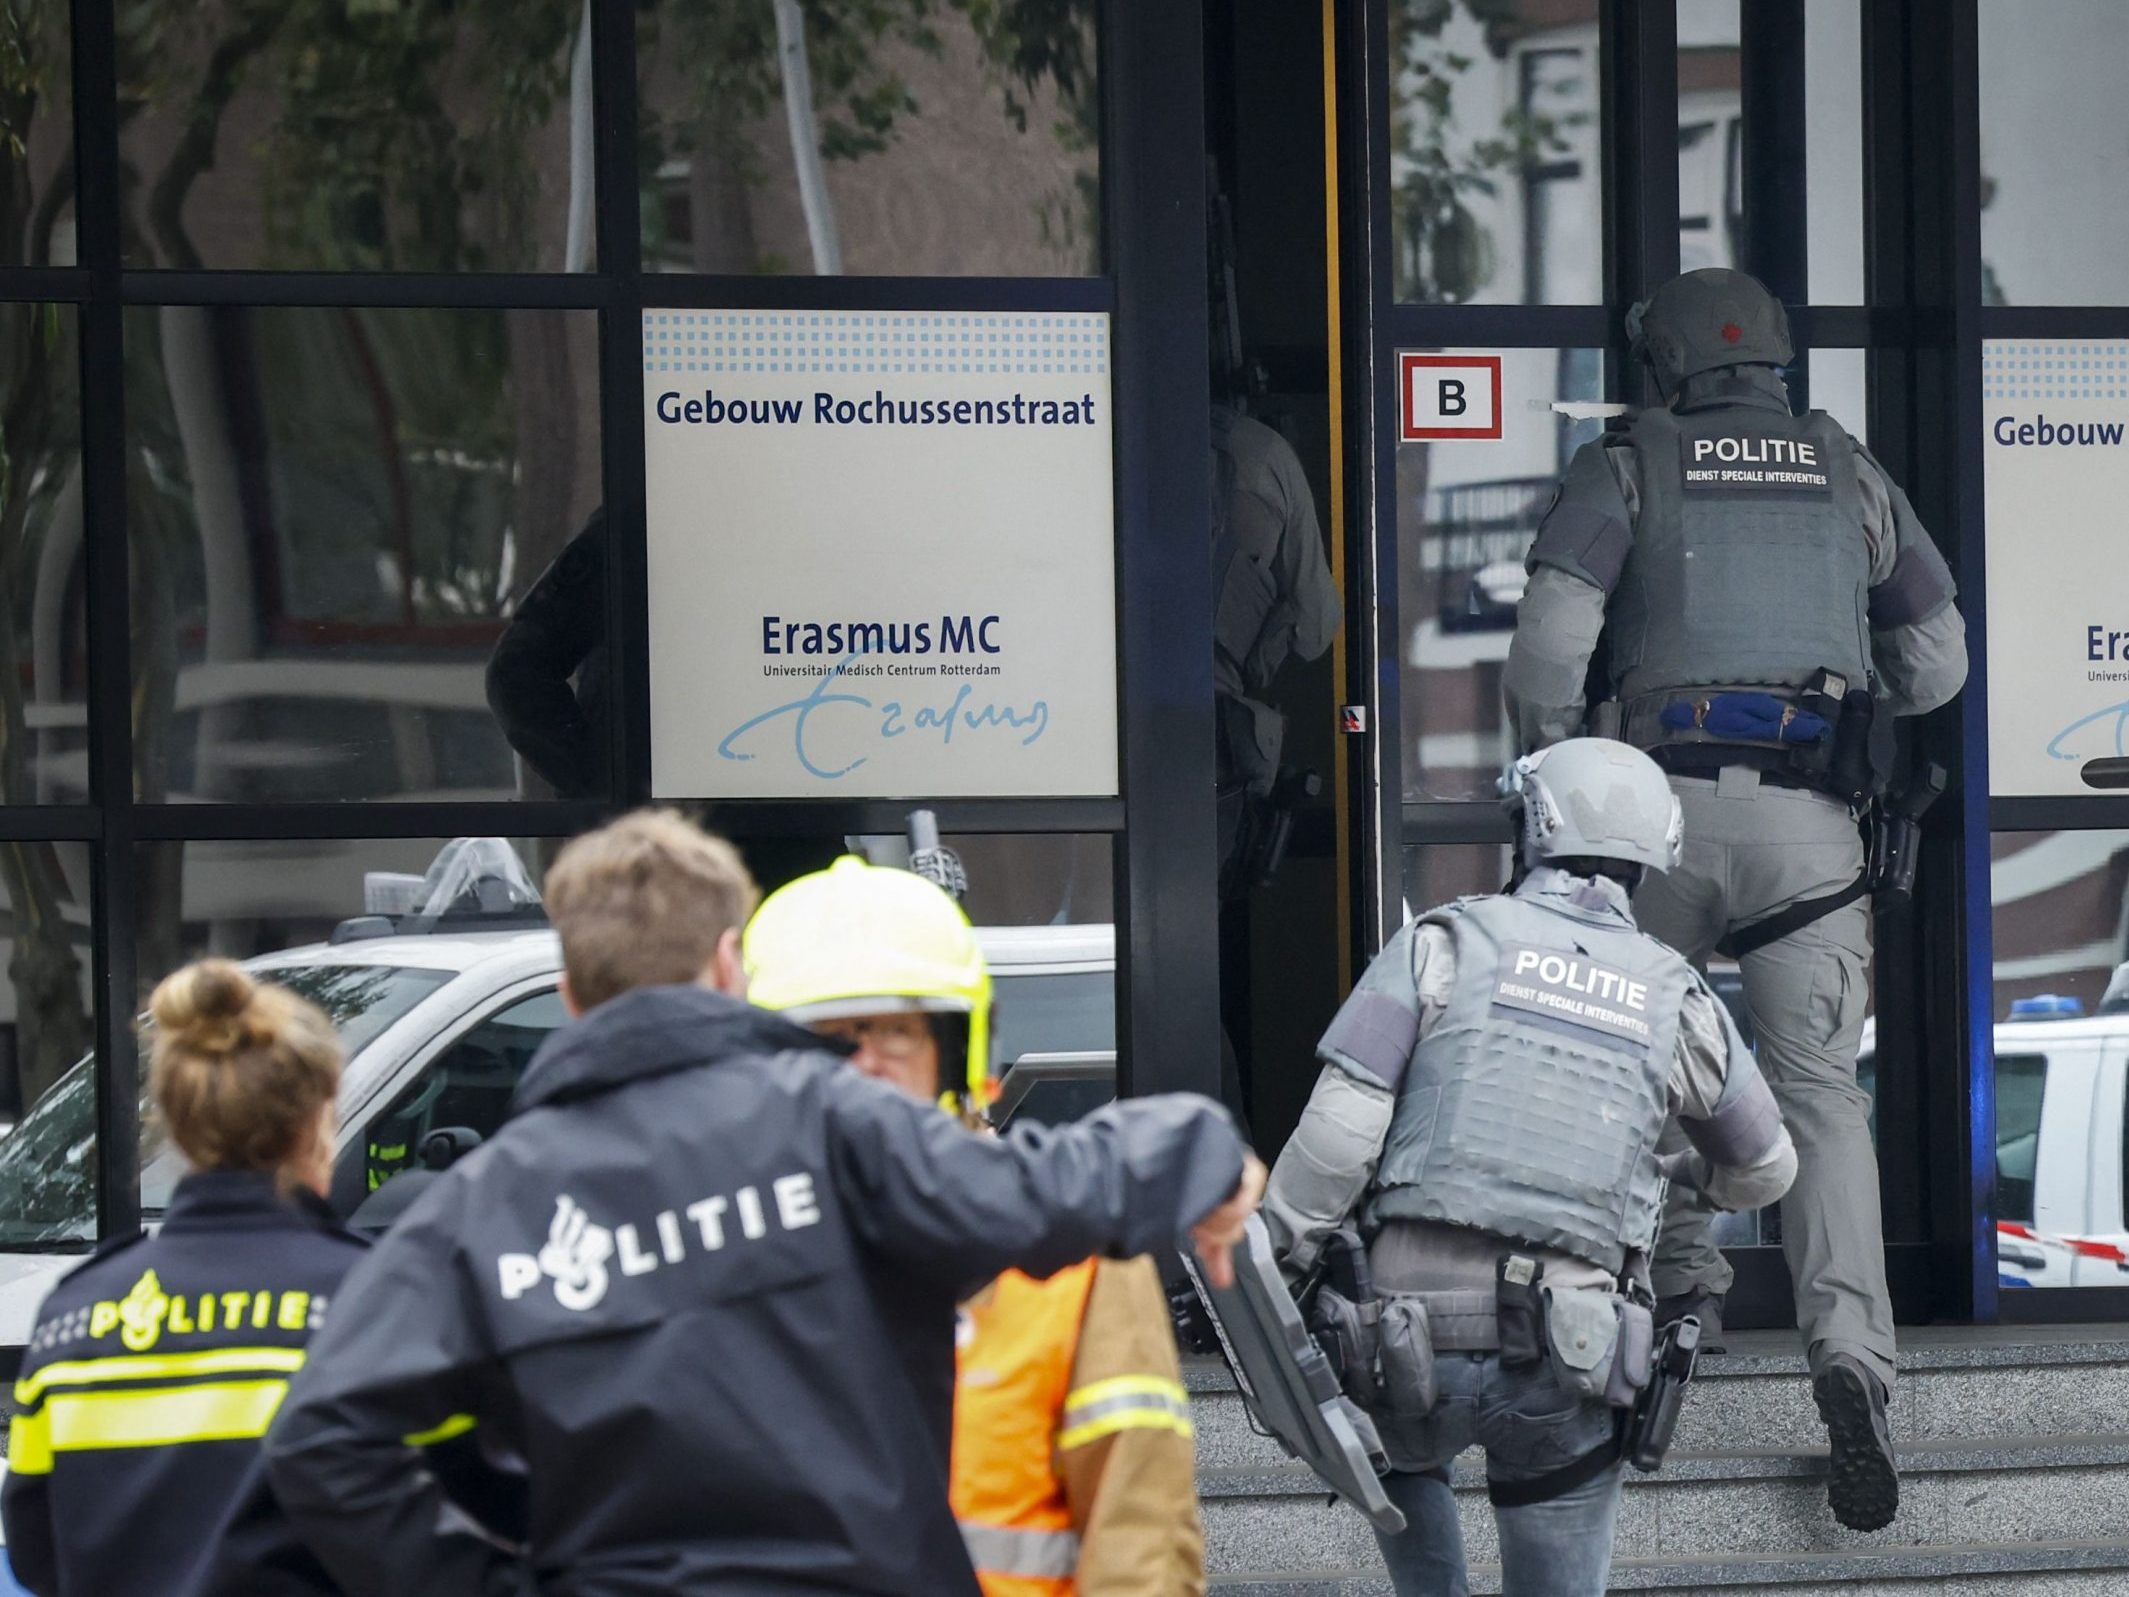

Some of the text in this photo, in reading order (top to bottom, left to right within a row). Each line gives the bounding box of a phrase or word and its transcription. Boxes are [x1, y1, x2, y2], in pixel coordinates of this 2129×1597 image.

[656, 390, 1096, 426] Gebouw Rochussenstraat
[1438, 379, 1467, 416] B
[1993, 414, 2125, 446] Gebouw
[1693, 437, 1818, 466] POLITIE
[1686, 469, 1827, 486] DIENST SPECIALE INTERVENTIES
[762, 615, 1001, 655] Erasmus MC
[763, 663, 1001, 677] Universitair Medisch Centrum Rotterdam
[1514, 950, 1649, 1012] POLITIE
[1499, 981, 1650, 1036] DIENST SPECIALE INTERVENTIES
